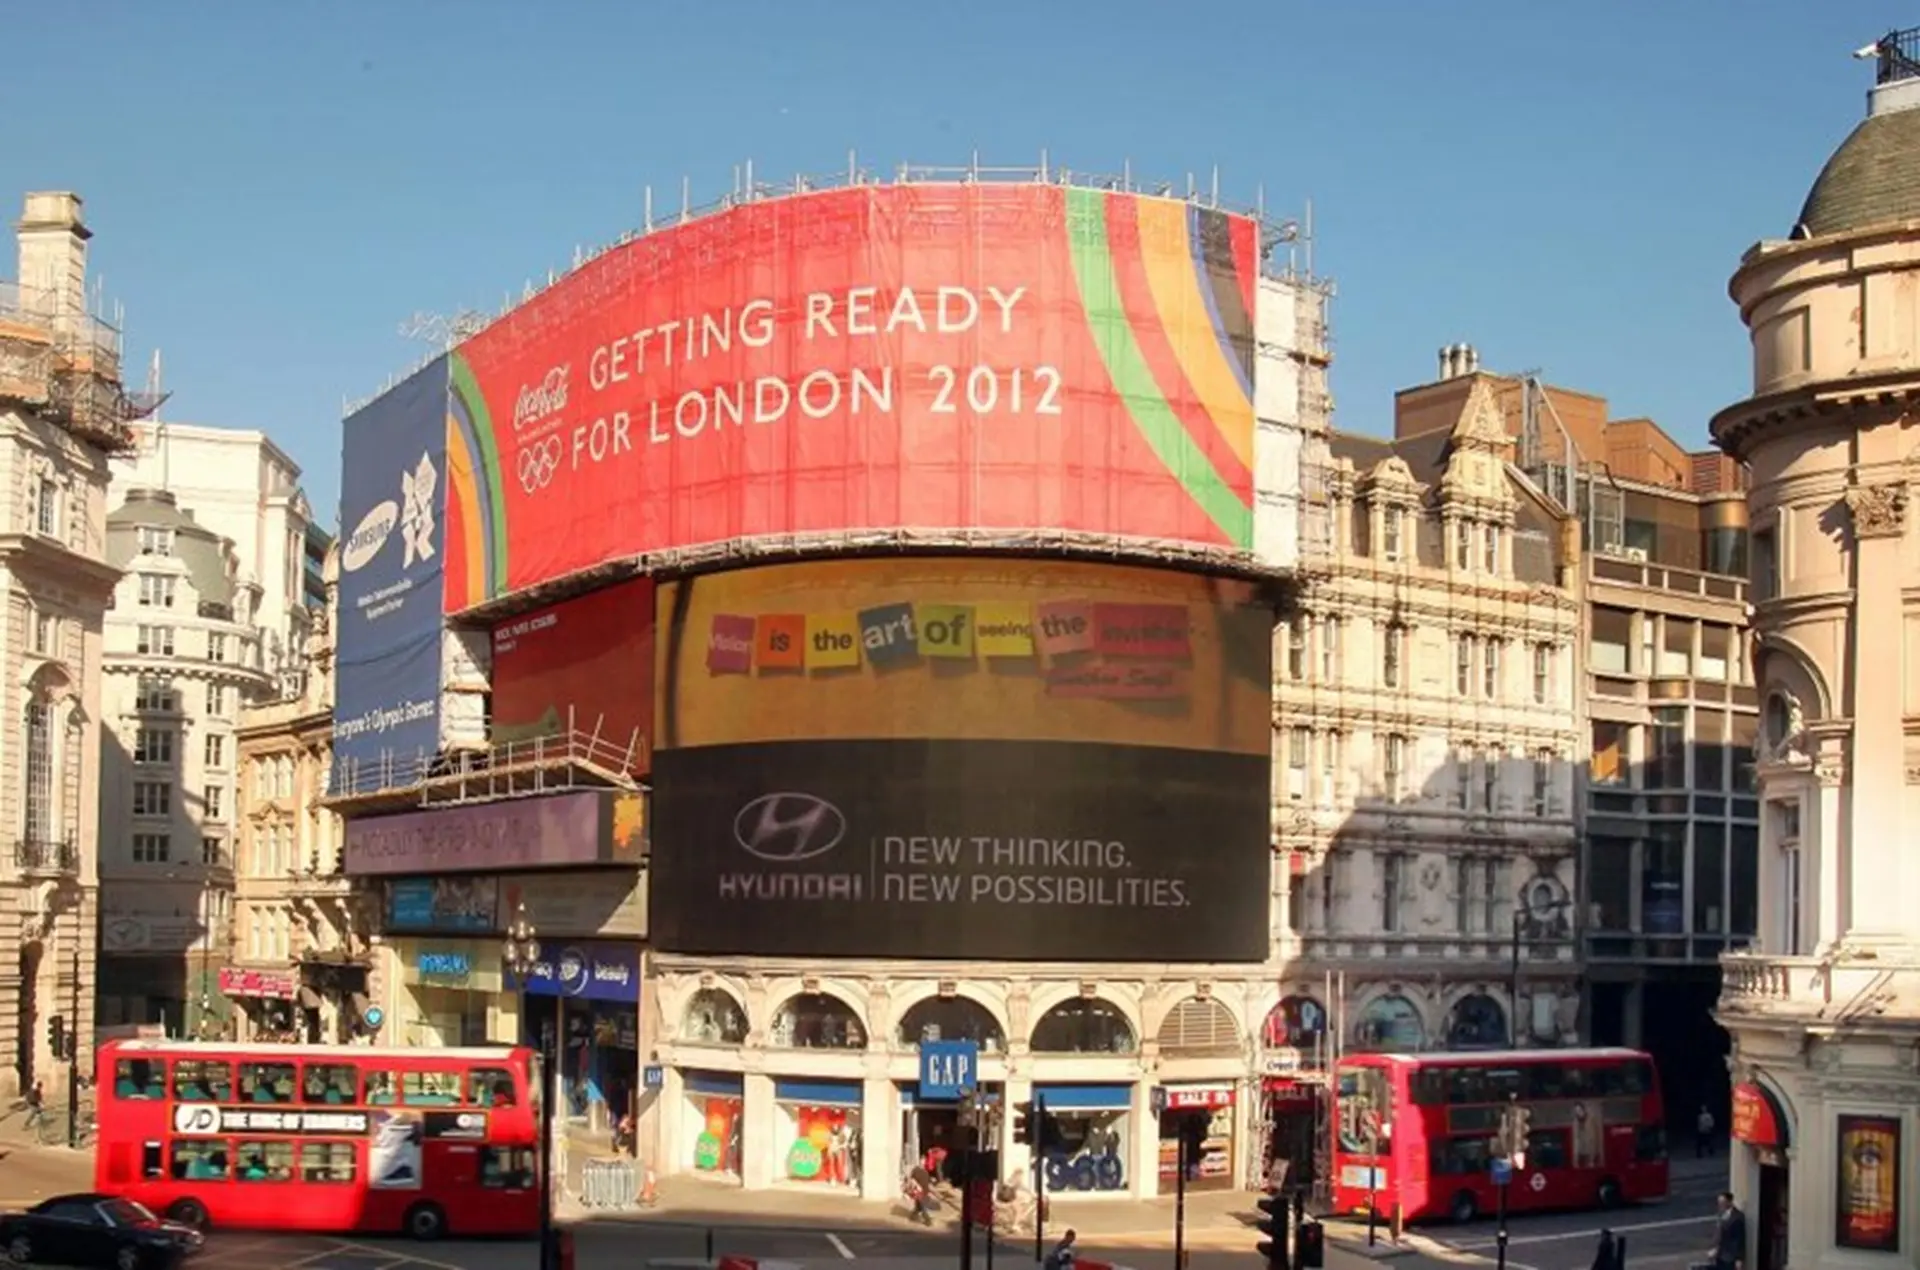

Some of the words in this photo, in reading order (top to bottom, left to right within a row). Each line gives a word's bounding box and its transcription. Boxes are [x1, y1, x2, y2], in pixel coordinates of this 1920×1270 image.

[589, 299, 775, 390] GETTING
[805, 286, 1026, 339] READY
[571, 411, 632, 471] FOR
[650, 366, 893, 444] LONDON
[928, 364, 1062, 414] 2012
[770, 628, 790, 652] is
[813, 627, 853, 652] the
[863, 613, 917, 650] art
[924, 613, 966, 646] of
[1041, 614, 1087, 638] the
[884, 837, 962, 864] NEW
[970, 838, 1132, 868] THINKING.
[719, 873, 862, 899] HYUNDAI
[884, 873, 961, 901] NEW
[970, 874, 1191, 906] POSSIBILITIES.
[929, 1054, 968, 1085] GAP
